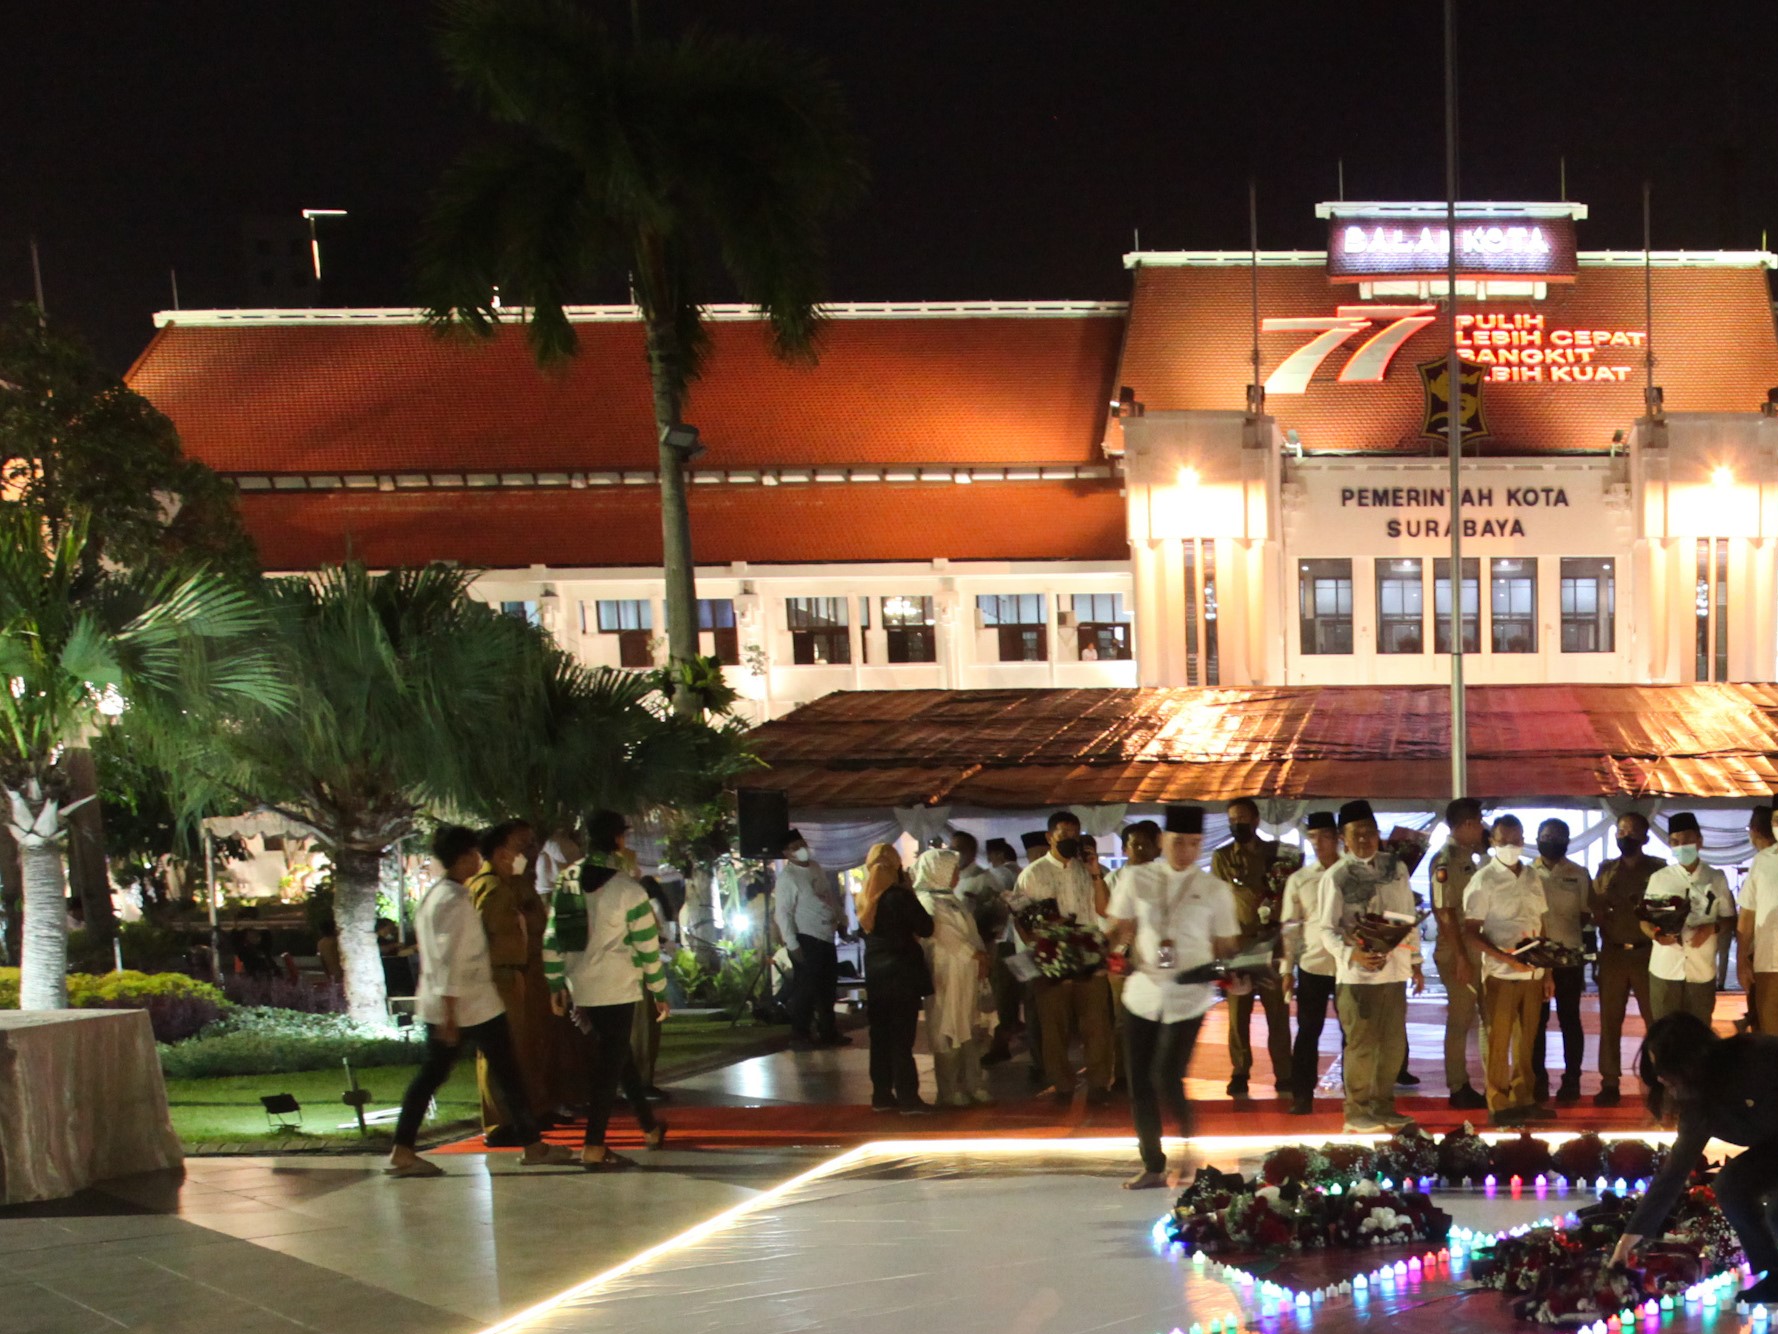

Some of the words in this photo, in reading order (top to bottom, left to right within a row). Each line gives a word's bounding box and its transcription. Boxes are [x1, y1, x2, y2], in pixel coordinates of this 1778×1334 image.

[1344, 226, 1449, 253] BALAI
[1462, 226, 1550, 253] KOTA
[1455, 313, 1545, 330] PULIH
[1455, 330, 1542, 346] LEBIH
[1549, 330, 1647, 346] CEPAT
[1262, 305, 1438, 394] 77
[1456, 347, 1595, 364] BANGKIT
[1484, 366, 1543, 382] BIH
[1550, 366, 1632, 382] KUAT
[1341, 488, 1493, 507] PEMERINAH
[1506, 488, 1570, 507] KOTA
